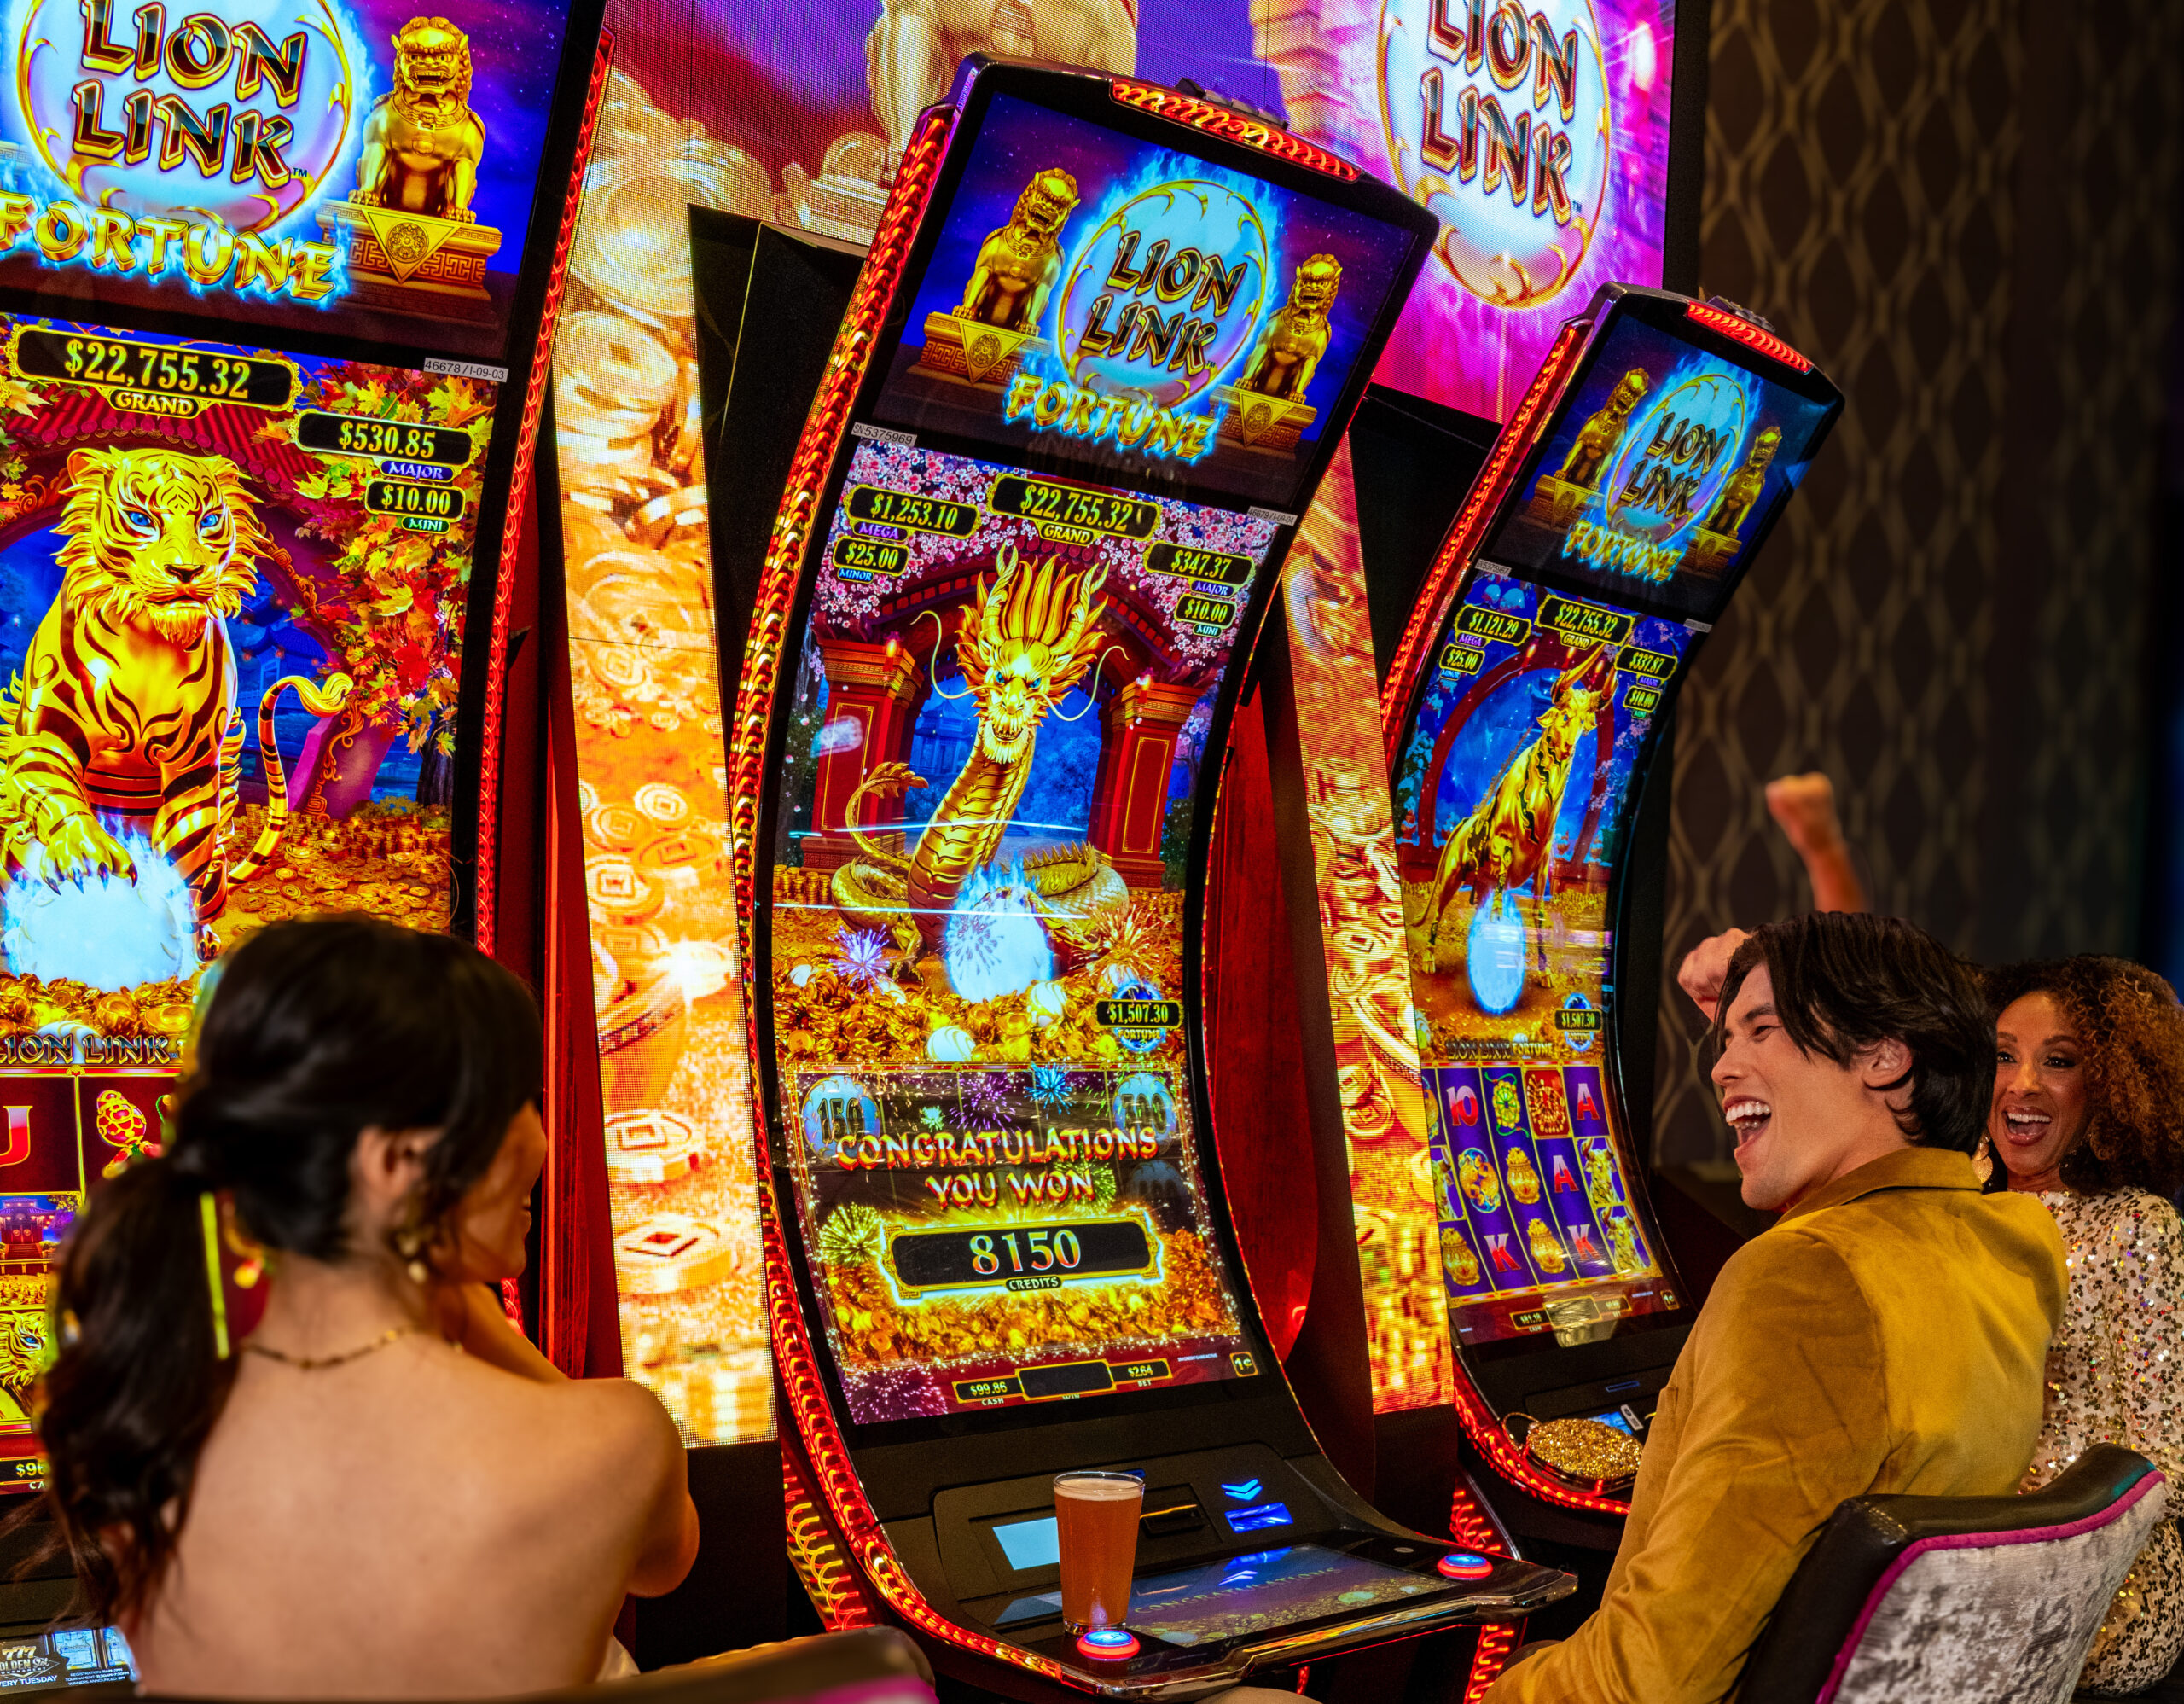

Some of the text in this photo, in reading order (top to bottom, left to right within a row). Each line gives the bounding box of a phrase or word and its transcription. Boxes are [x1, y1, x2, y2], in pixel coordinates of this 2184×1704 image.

[81, 0, 308, 108] LION
[1428, 0, 1577, 124] LION
[73, 79, 293, 189] LINK
[1421, 67, 1571, 226] LINK
[0, 189, 339, 301] FORTUNE
[1105, 230, 1248, 317] LION
[1079, 294, 1217, 376] LINK
[65, 339, 251, 400] $22,755.32
[425, 360, 461, 374] 46678
[115, 391, 192, 417] GRAND
[1006, 373, 1217, 459] FORTUNE
[339, 421, 436, 458] $530.85
[1646, 412, 1729, 474] LION
[389, 462, 444, 480] MAJOR
[381, 484, 451, 515] $10.00
[1619, 459, 1701, 521] LINK
[871, 493, 958, 531] $1,253.10
[1020, 484, 1134, 532] $22,755.32
[409, 517, 443, 532] MINI
[858, 522, 899, 539] MEGA
[1043, 524, 1091, 544] GRAND
[845, 542, 899, 569] $25.00
[1170, 550, 1232, 579] $347.37
[1565, 519, 1683, 582] FORTUNE
[839, 570, 873, 582] MINOR
[1195, 581, 1228, 596] MAJOR
[1185, 599, 1228, 622] $10.00
[1468, 611, 1519, 639] $1,121.29
[1554, 602, 1618, 639] $22,755.32
[1196, 625, 1219, 635] MINI
[1459, 633, 1482, 646] MEGA
[1563, 635, 1591, 648] GRAND
[1447, 648, 1478, 669] $25.00
[1109, 1003, 1169, 1024] $1,507.30
[83, 1033, 171, 1065] LINK
[1118, 1029, 1161, 1040] FORTUNE
[1512, 1042, 1554, 1056] FORTUNE
[1577, 1083, 1600, 1120] A
[836, 1127, 1159, 1171] CONGRATULATIONS
[1553, 1154, 1579, 1193] A
[926, 1170, 997, 1210] YOU
[1006, 1169, 1096, 1207] WON
[969, 1228, 1081, 1275] 8150
[1484, 1233, 1521, 1272] K
[1567, 1224, 1599, 1261] K
[1008, 1277, 1059, 1292] CREDITS
[970, 1381, 1008, 1397] $99.86
[1137, 1379, 1152, 1387] BET
[981, 1398, 1004, 1406] CASH
[0, 1659, 32, 1672] OLDEN
[2, 1645, 37, 1661] 777
[20, 1675, 58, 1685] TUESDAY
